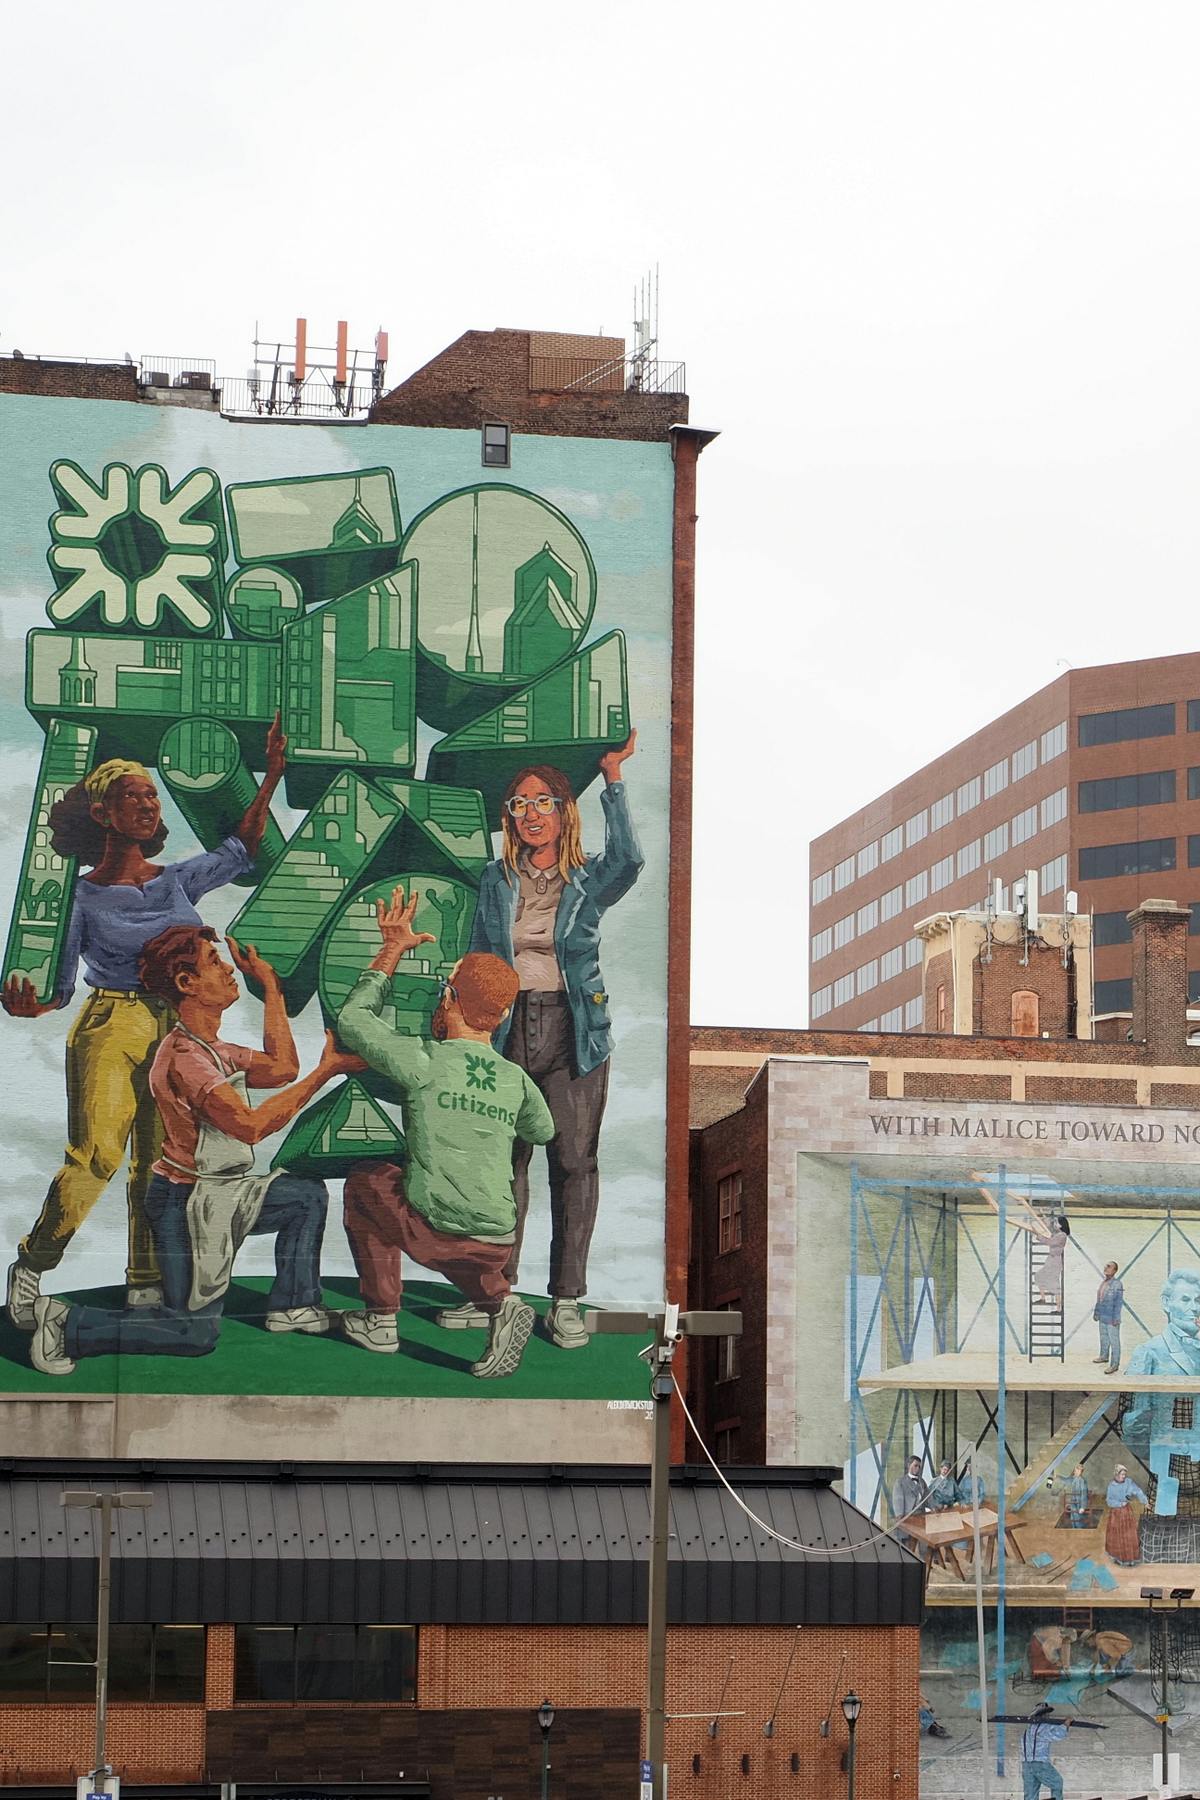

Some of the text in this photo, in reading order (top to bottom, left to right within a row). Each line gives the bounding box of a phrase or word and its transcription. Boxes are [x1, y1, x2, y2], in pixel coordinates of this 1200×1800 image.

[437, 1091, 515, 1127] Citizens
[869, 1115, 940, 1137] WITH
[950, 1118, 1048, 1140] MALICE
[1056, 1120, 1164, 1143] TOWARD
